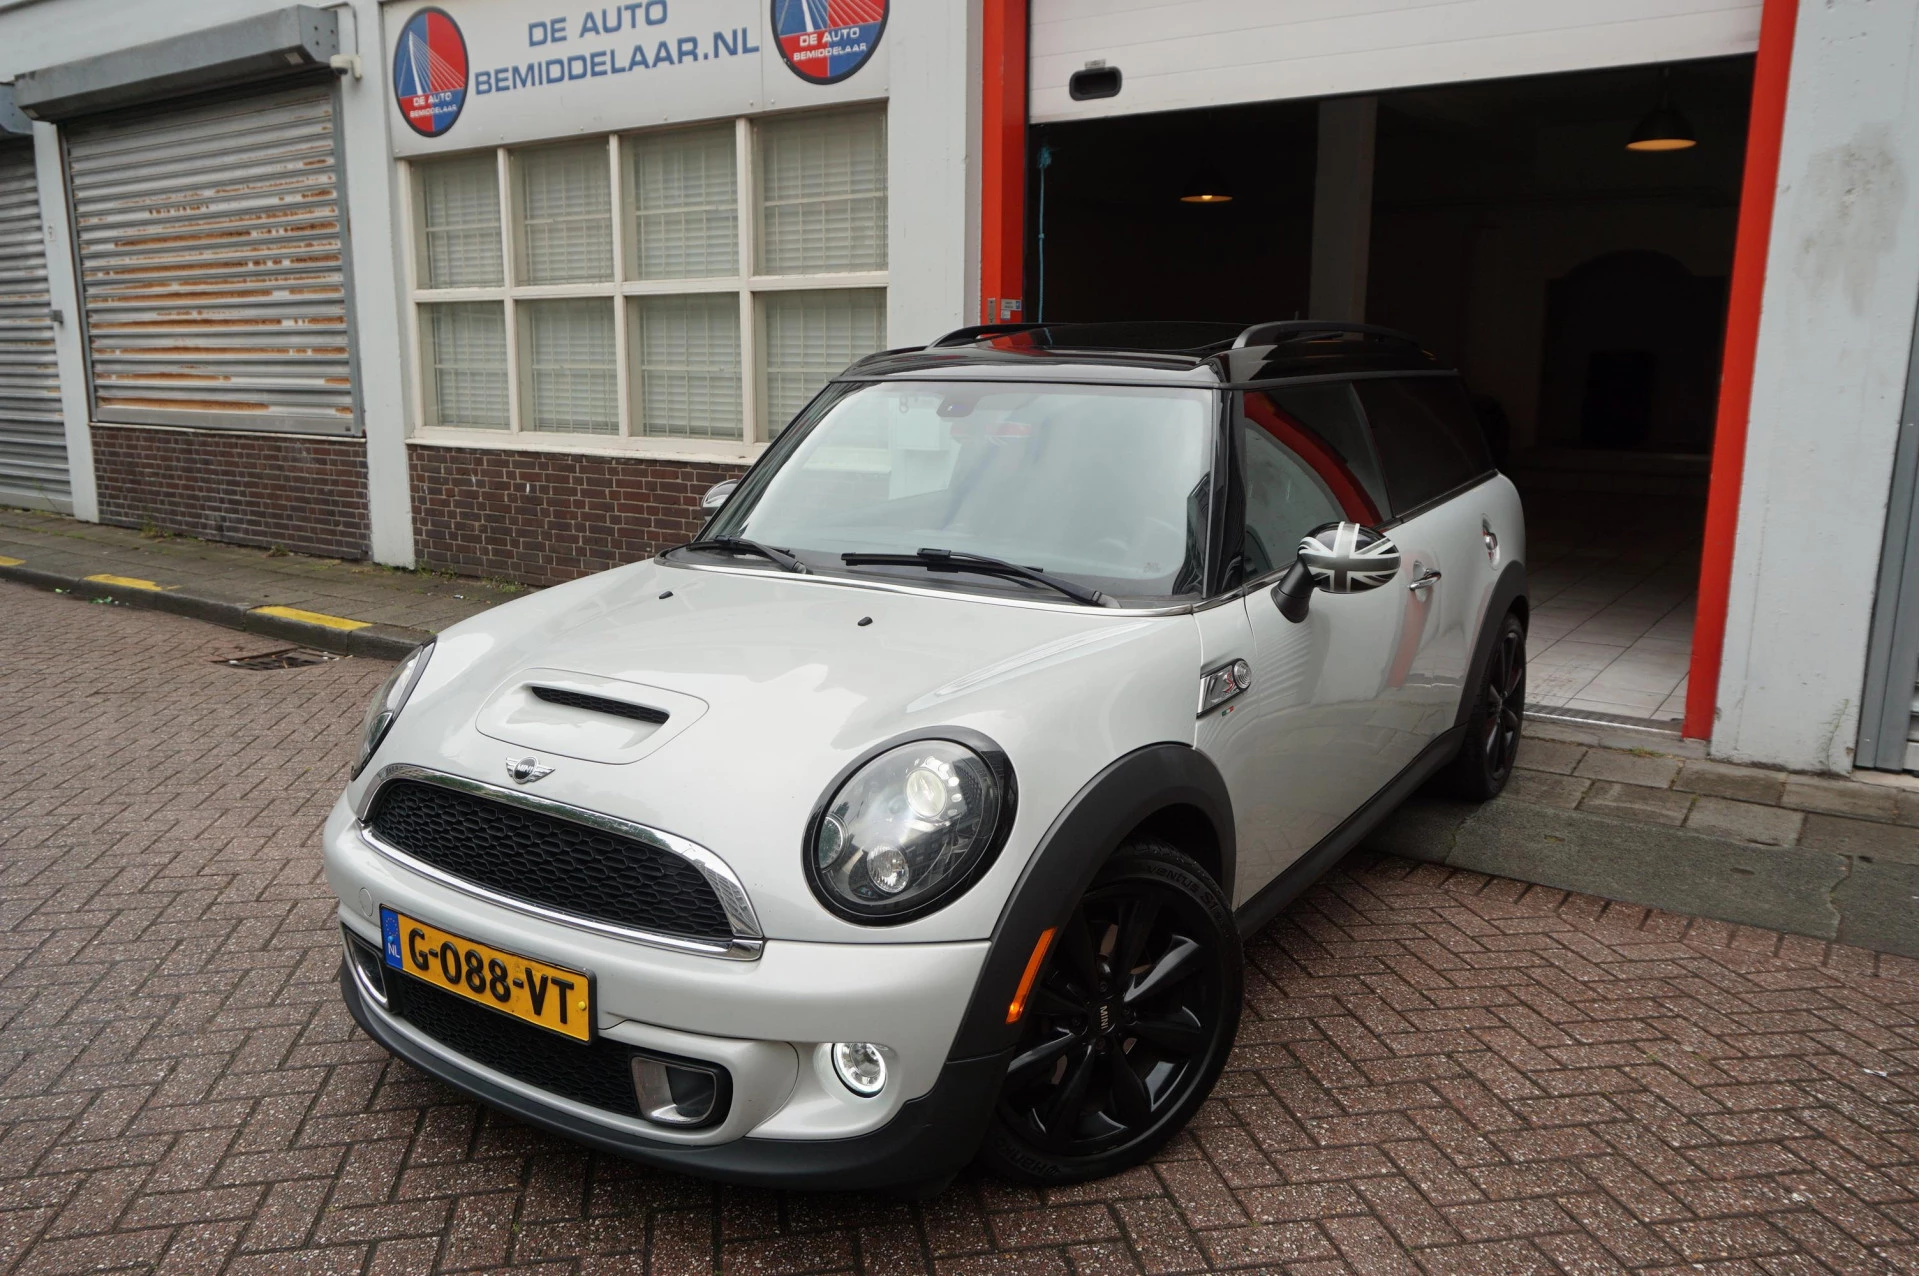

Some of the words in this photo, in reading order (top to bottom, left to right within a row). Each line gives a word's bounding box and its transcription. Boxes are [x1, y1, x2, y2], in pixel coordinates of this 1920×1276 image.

[528, 16, 568, 47] DE
[579, 0, 668, 38] AUTO
[799, 33, 818, 47] DE
[822, 27, 860, 43] AUTO
[474, 26, 760, 95] BEMIDDELAAR.NL
[793, 42, 867, 61] BEMIDDELAAR
[413, 96, 426, 107] DE
[427, 92, 452, 104] AUTO
[410, 104, 457, 118] BEMIDDELAAR
[387, 942, 401, 959] NL
[408, 927, 575, 1025] G-088-VT
[1099, 1004, 1109, 1030] MINI
